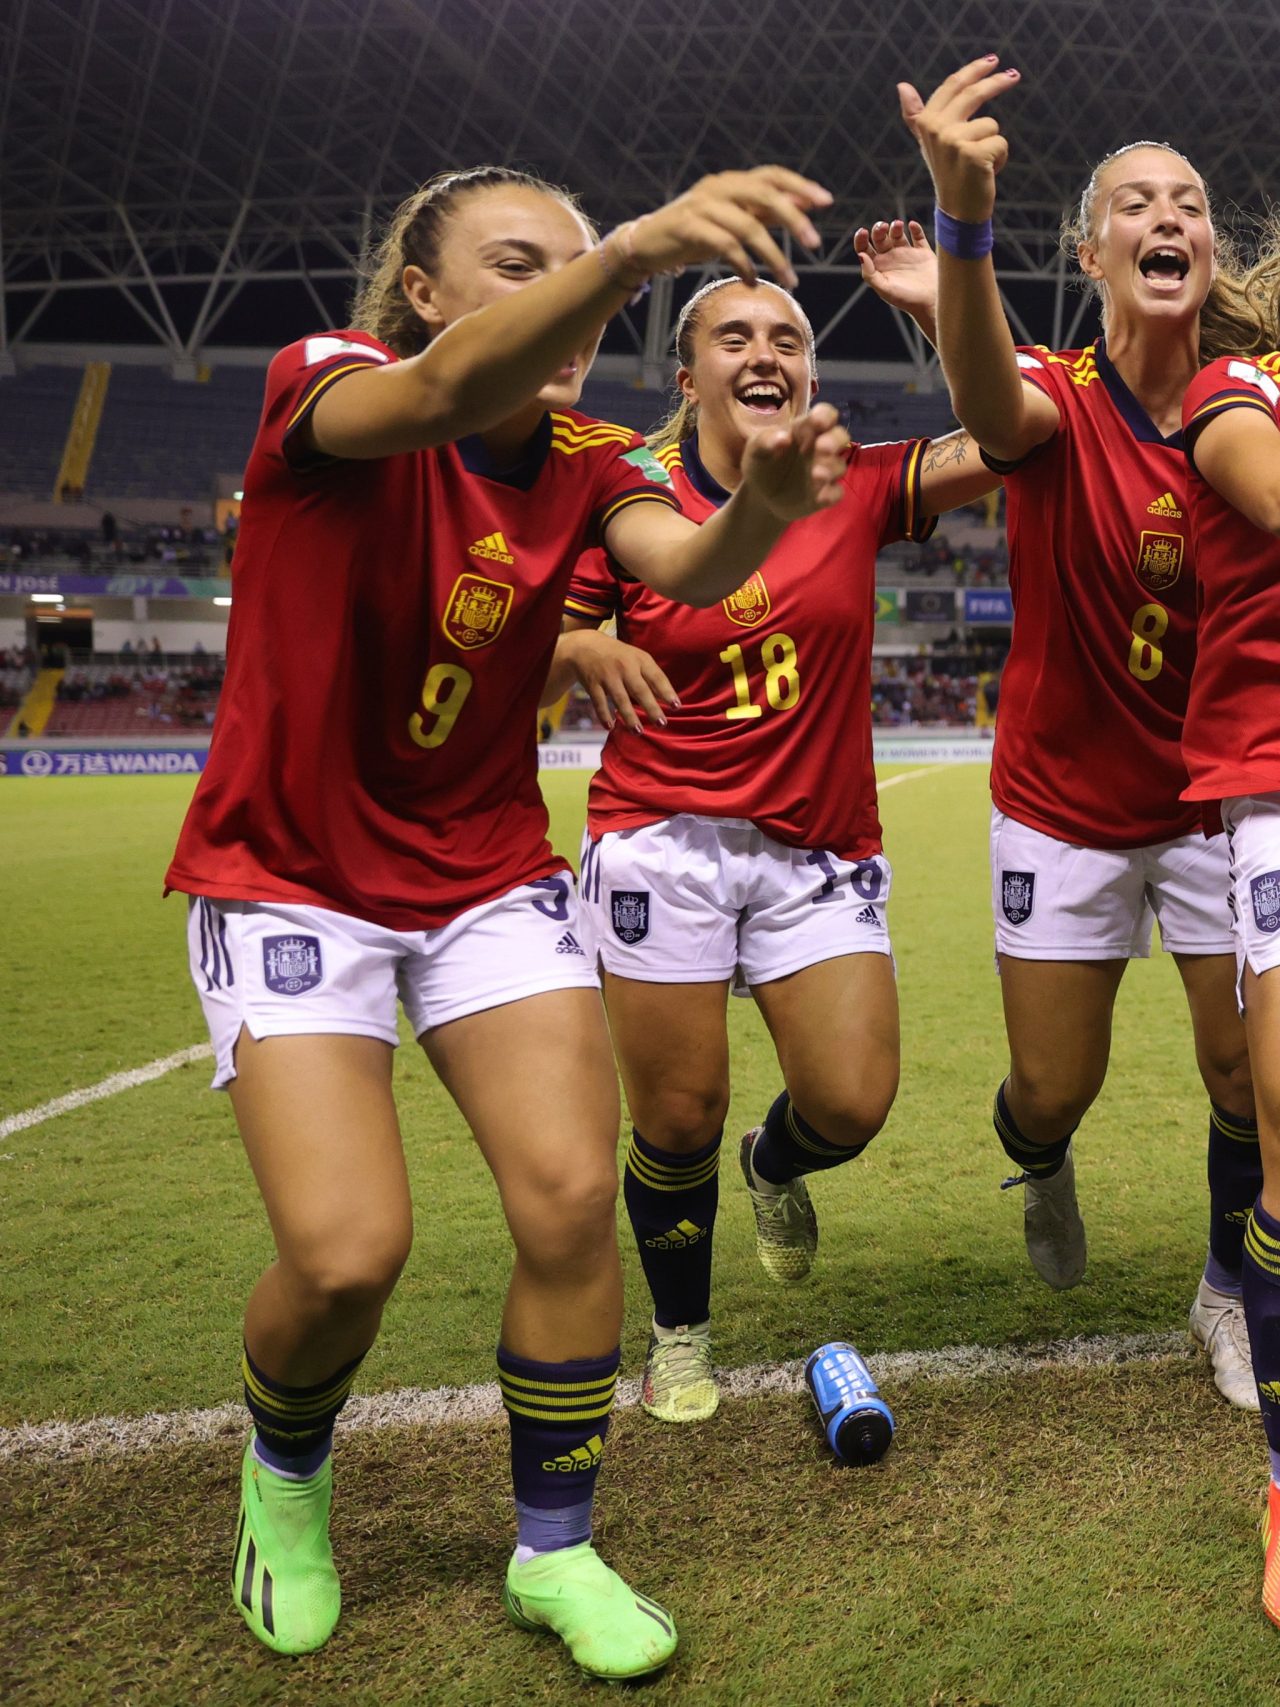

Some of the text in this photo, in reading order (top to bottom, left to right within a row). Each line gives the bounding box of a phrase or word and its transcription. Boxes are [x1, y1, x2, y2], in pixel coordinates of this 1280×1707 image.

[1147, 503, 1183, 519] adidas
[468, 545, 515, 566] adidas
[1127, 602, 1169, 682] 8
[719, 632, 801, 720] 18
[407, 662, 473, 749] 9
[109, 752, 200, 774] WANDA
